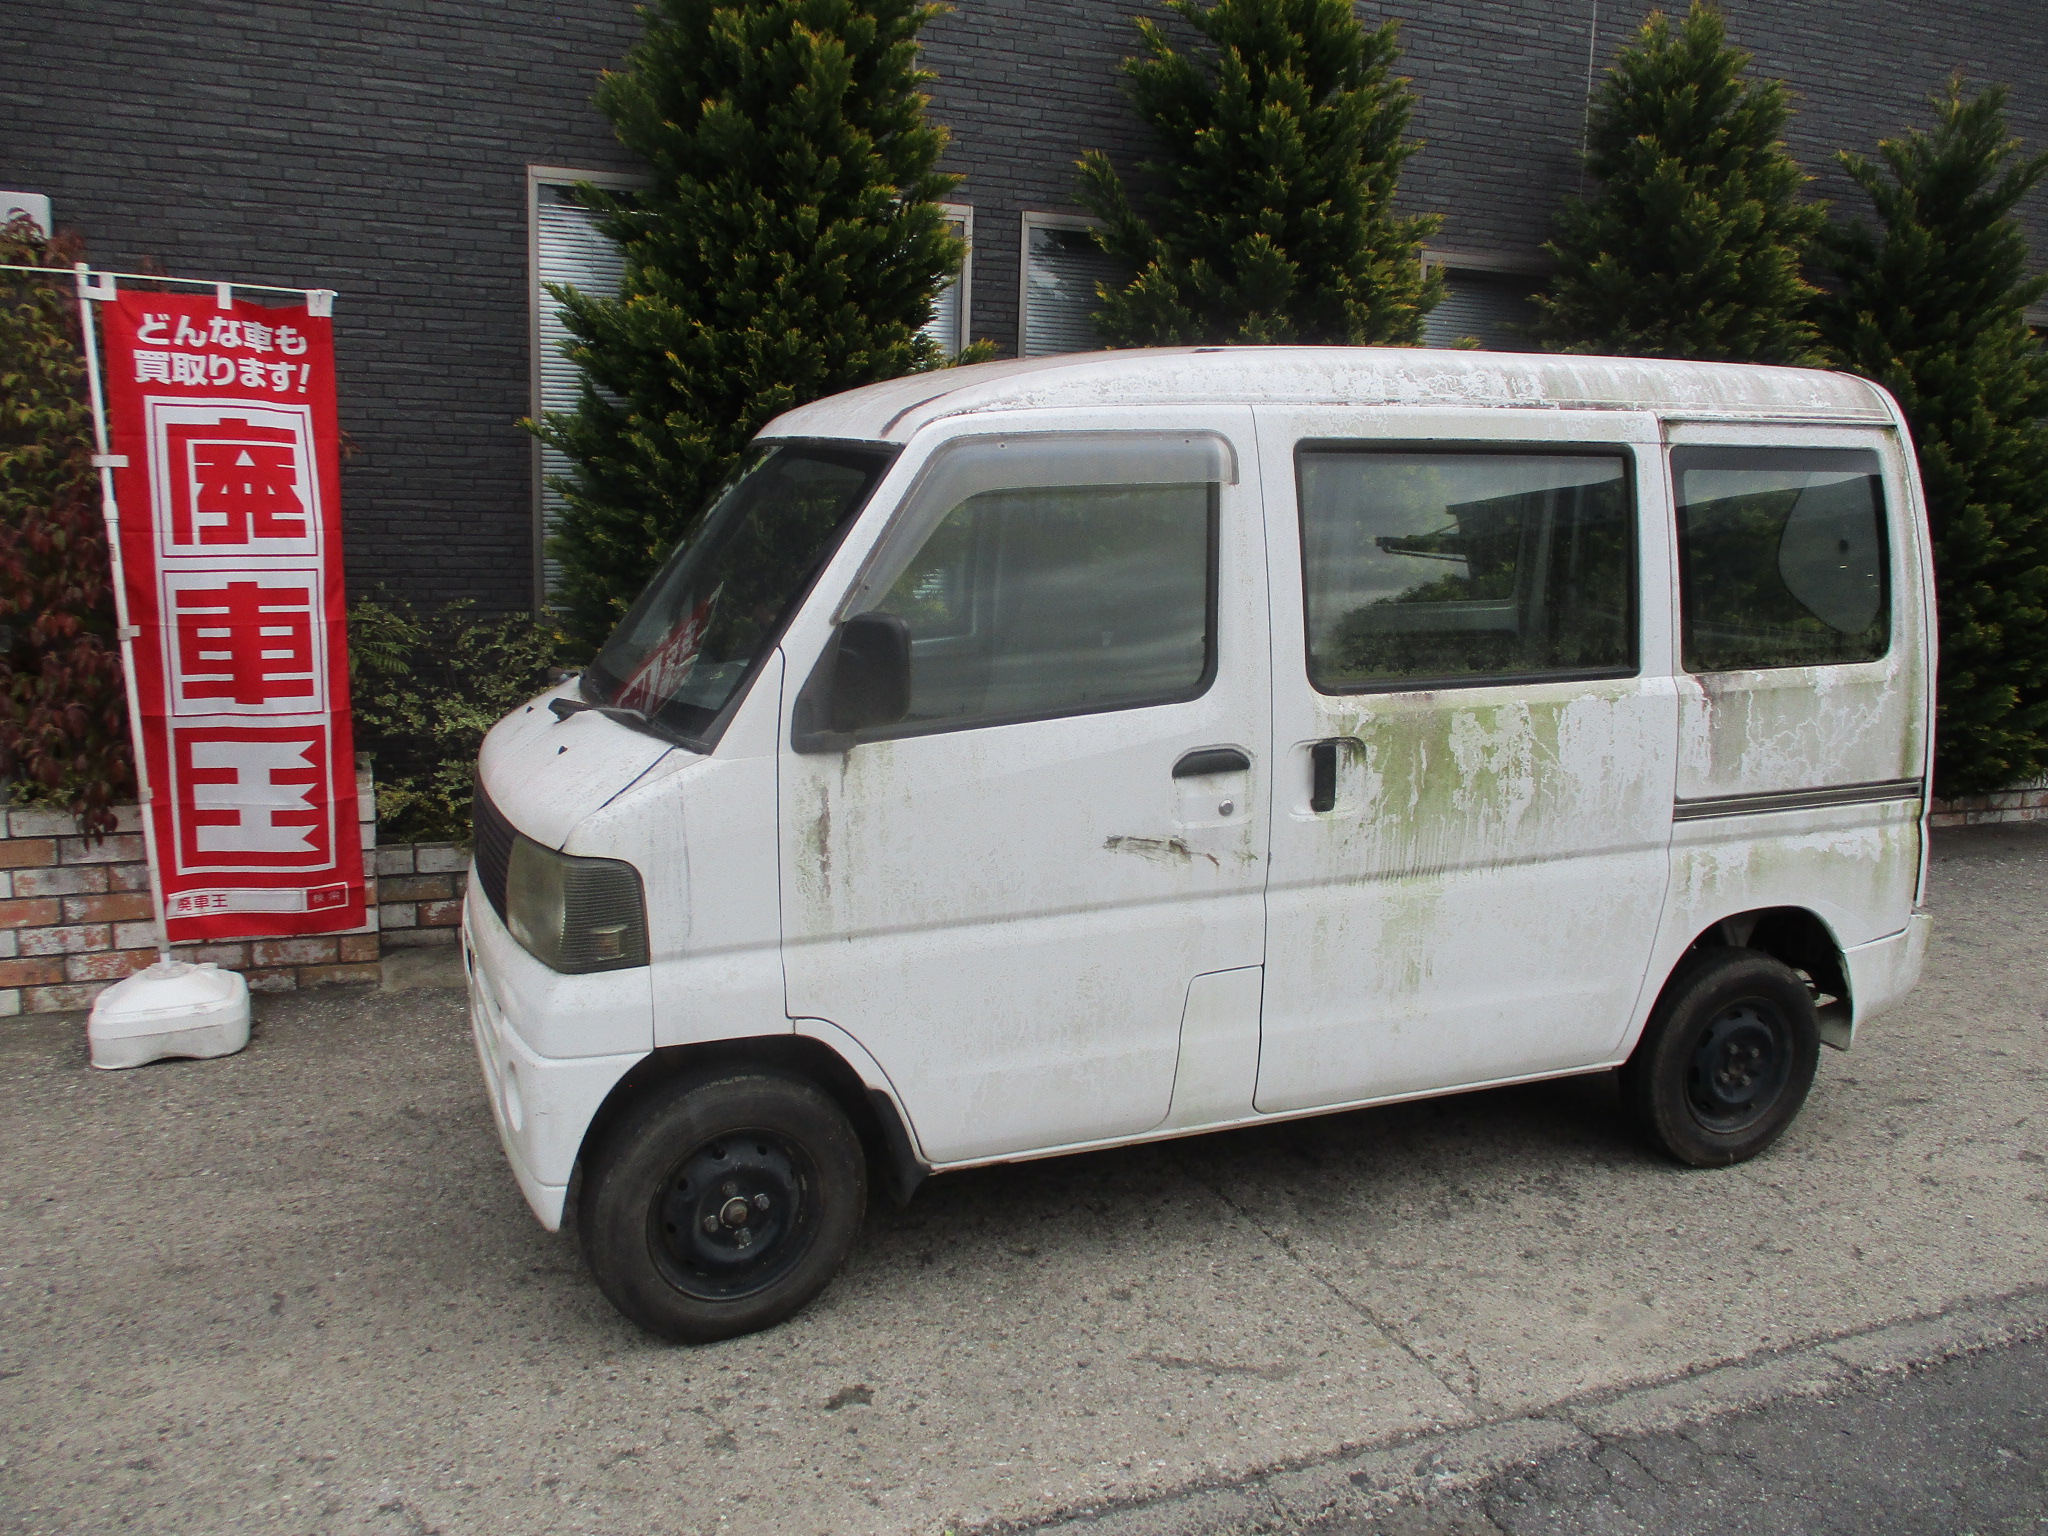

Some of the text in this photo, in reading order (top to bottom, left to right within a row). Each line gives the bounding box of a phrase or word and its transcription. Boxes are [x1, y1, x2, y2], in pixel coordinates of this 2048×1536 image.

[137, 313, 307, 355] どんな車も
[135, 351, 310, 394] 買取ります!
[165, 417, 320, 853] 廃車王
[177, 894, 229, 912] 廃車王
